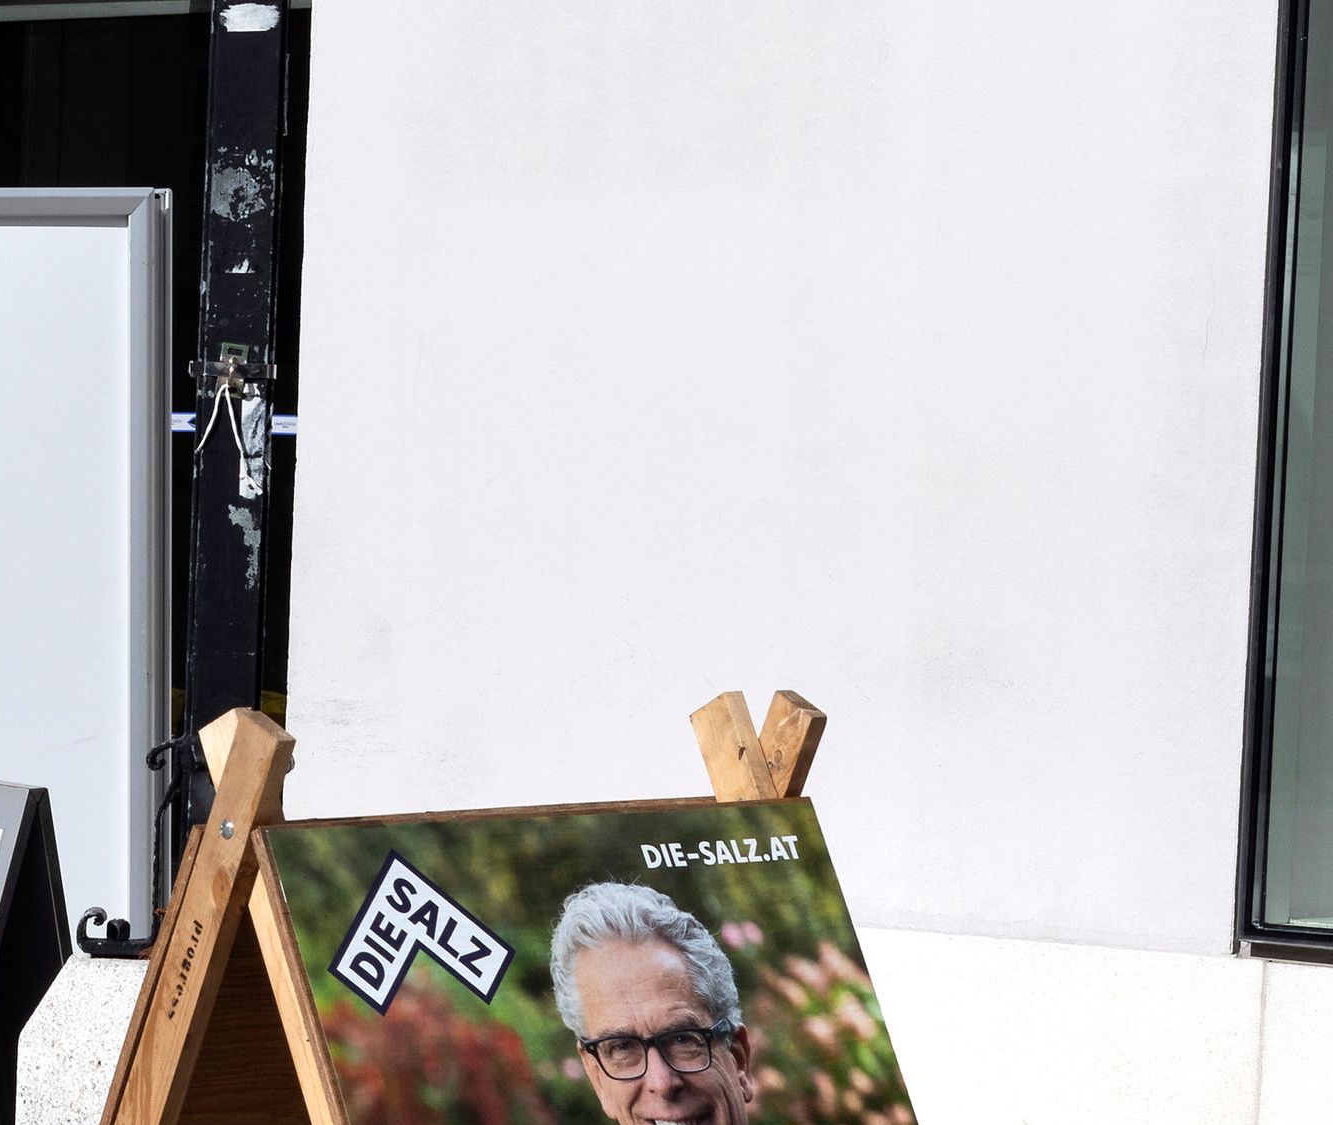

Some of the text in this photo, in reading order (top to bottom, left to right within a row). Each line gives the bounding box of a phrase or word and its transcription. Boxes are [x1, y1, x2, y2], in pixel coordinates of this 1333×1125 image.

[640, 835, 800, 869] DIE-SALZ.AT
[166, 919, 205, 1021] progress
[349, 878, 492, 991] DIE SALZ
